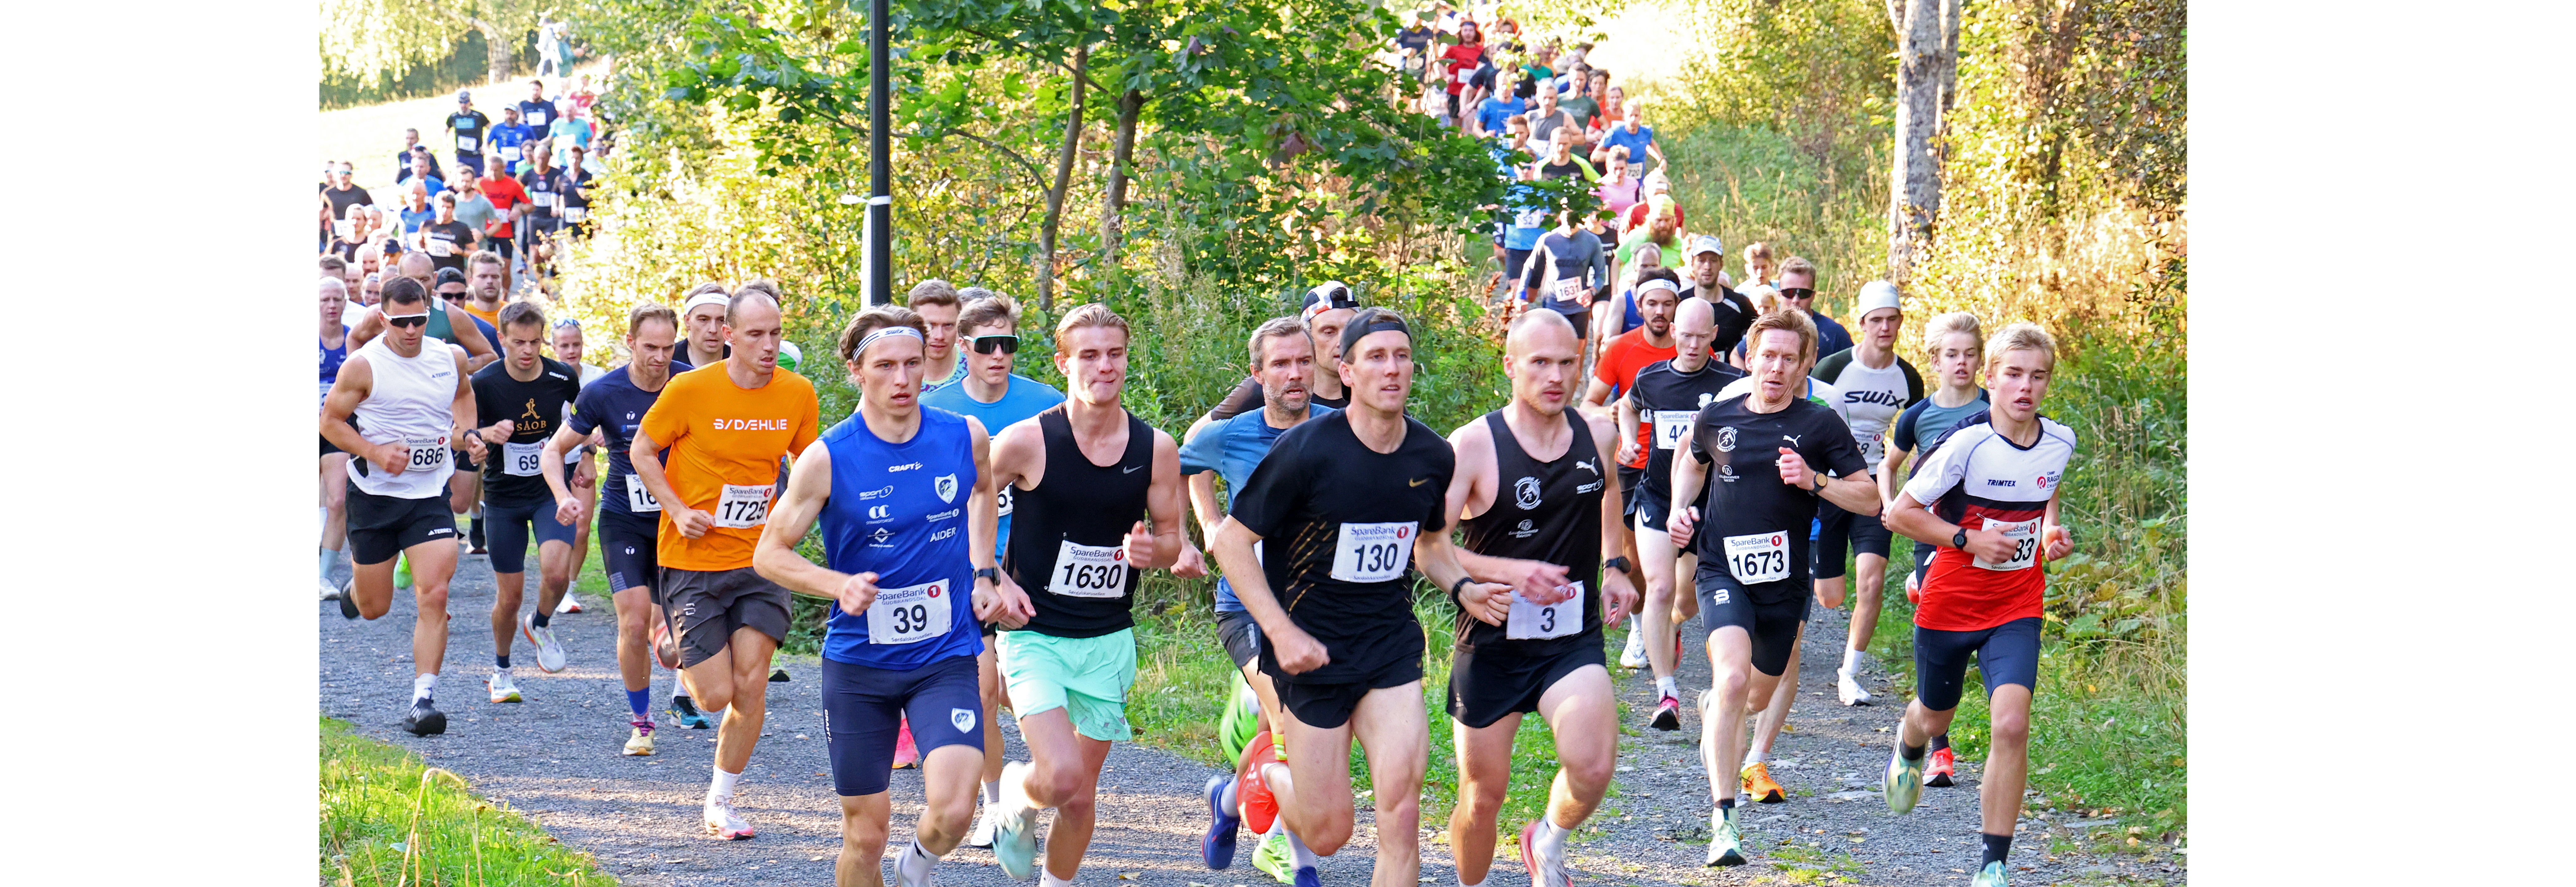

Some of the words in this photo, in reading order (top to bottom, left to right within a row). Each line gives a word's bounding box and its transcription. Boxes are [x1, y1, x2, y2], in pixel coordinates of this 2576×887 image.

[1559, 285, 1579, 297] 1631
[405, 447, 444, 465] 686
[519, 455, 538, 471] 69
[888, 463, 915, 473] CRAFT
[724, 500, 768, 521] 1725
[929, 527, 956, 542] AIDER
[1351, 526, 1395, 536] SpareBank
[1732, 537, 1770, 547] SpareBank
[1070, 547, 1114, 557] SpareBank
[1355, 543, 1398, 572] 130
[2002, 538, 2034, 563] 83
[1733, 550, 1784, 576] 1673
[1064, 563, 1122, 589] 1630
[877, 587, 926, 601] SpareBank
[882, 596, 927, 605] GUDBRANDSDAL
[893, 605, 927, 633] 39
[1540, 607, 1555, 632] 3
